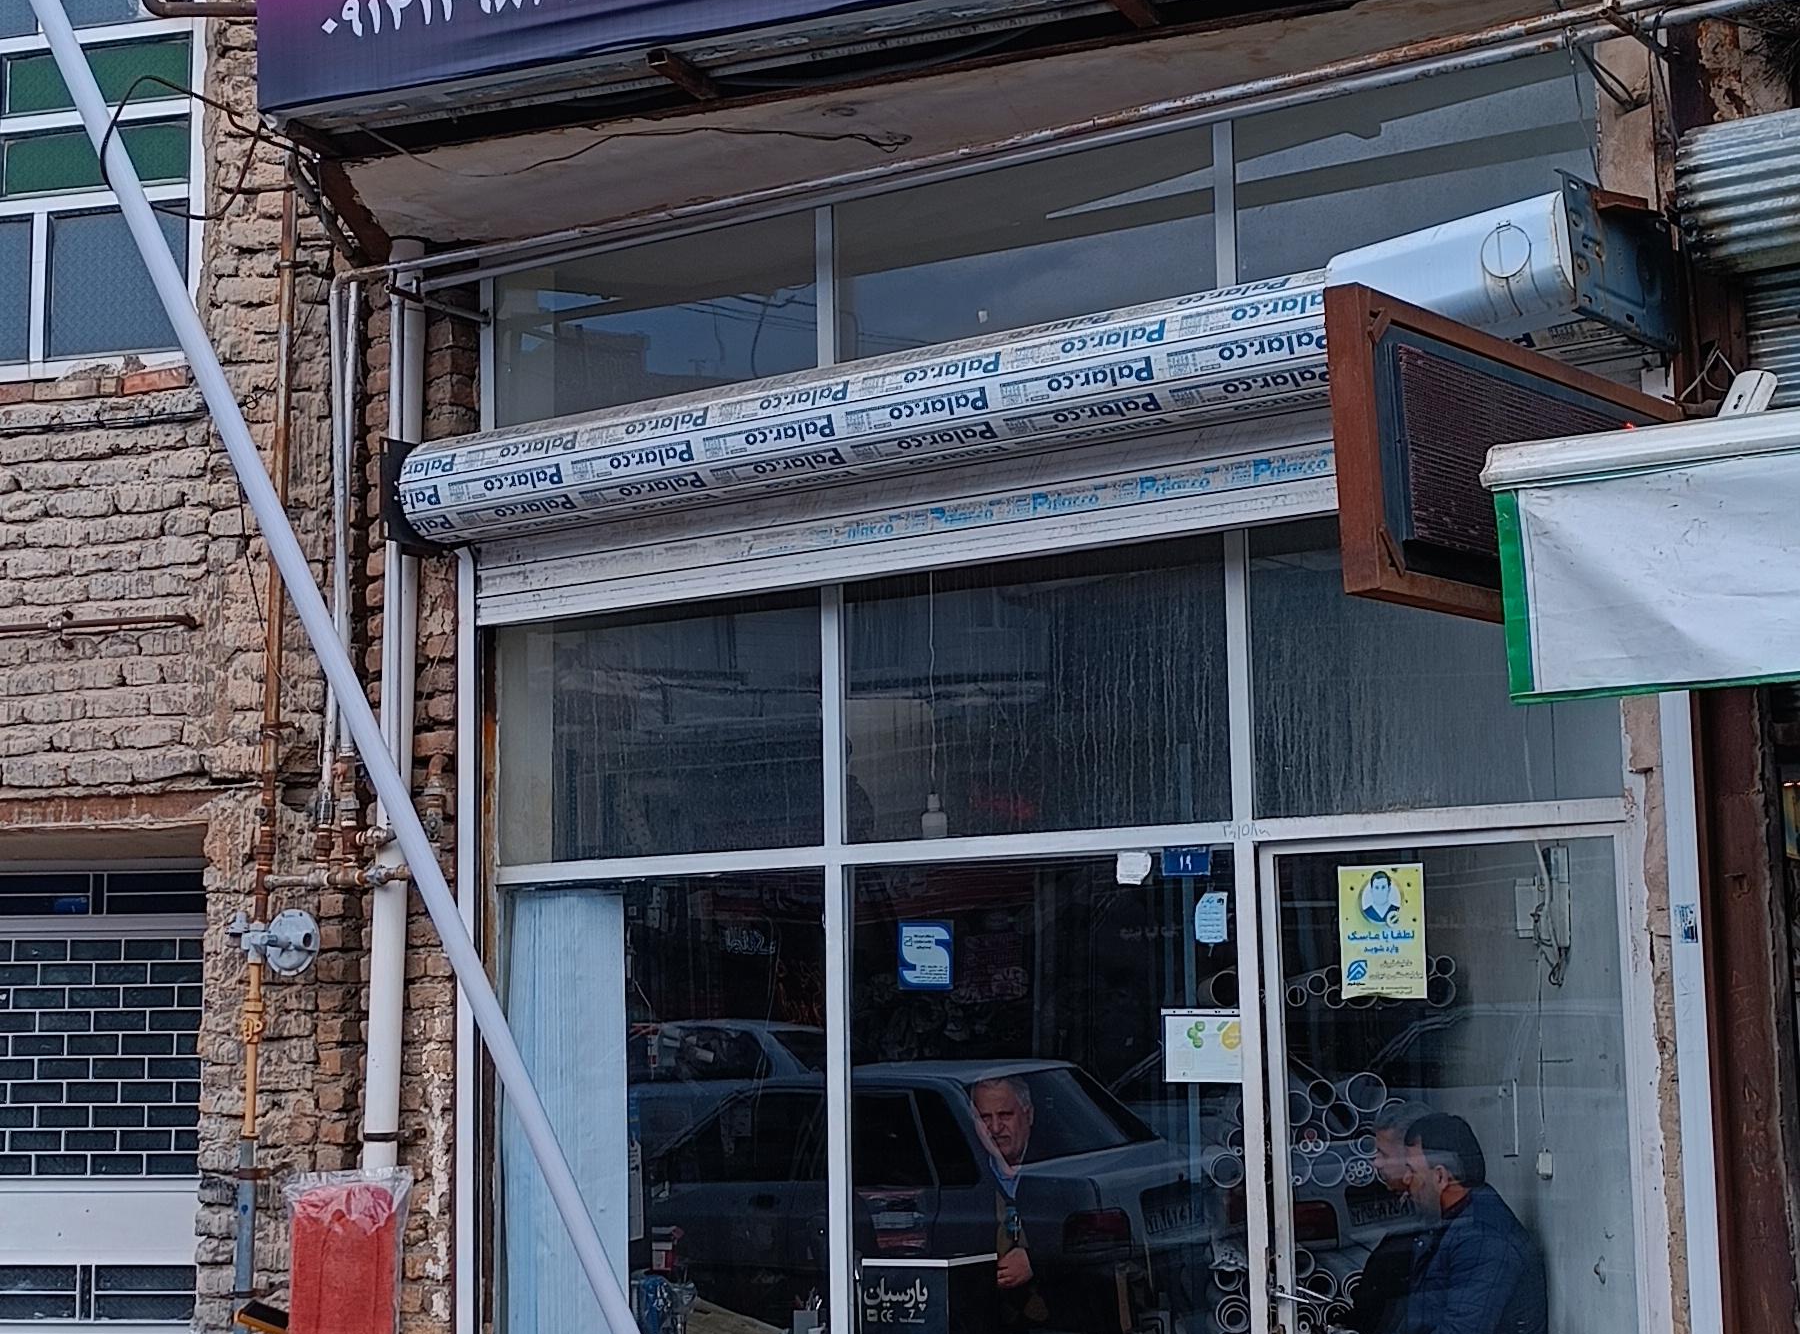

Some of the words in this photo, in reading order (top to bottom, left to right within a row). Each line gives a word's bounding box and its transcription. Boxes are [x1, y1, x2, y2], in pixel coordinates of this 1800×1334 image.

[1231, 292, 1323, 322] alar.co
[1061, 319, 1166, 355] Palar.co
[904, 352, 1001, 385] Palar.co
[1047, 356, 1154, 392] Palar.co
[759, 381, 850, 412] Palar.co
[889, 387, 988, 421] Palar.co
[1053, 393, 1162, 425] Palar.co
[625, 406, 708, 436] Palar.co
[745, 414, 835, 447] Palar.co
[897, 421, 998, 452] Palar.co
[500, 431, 578, 459] Palar.co
[609, 440, 694, 470] Palar.co
[753, 448, 846, 476] Palar.co
[483, 463, 563, 493] Palar.co
[619, 472, 707, 498] Palar.co
[495, 494, 577, 519] Palar.co
[863, 1277, 928, 1311] پارسیان
